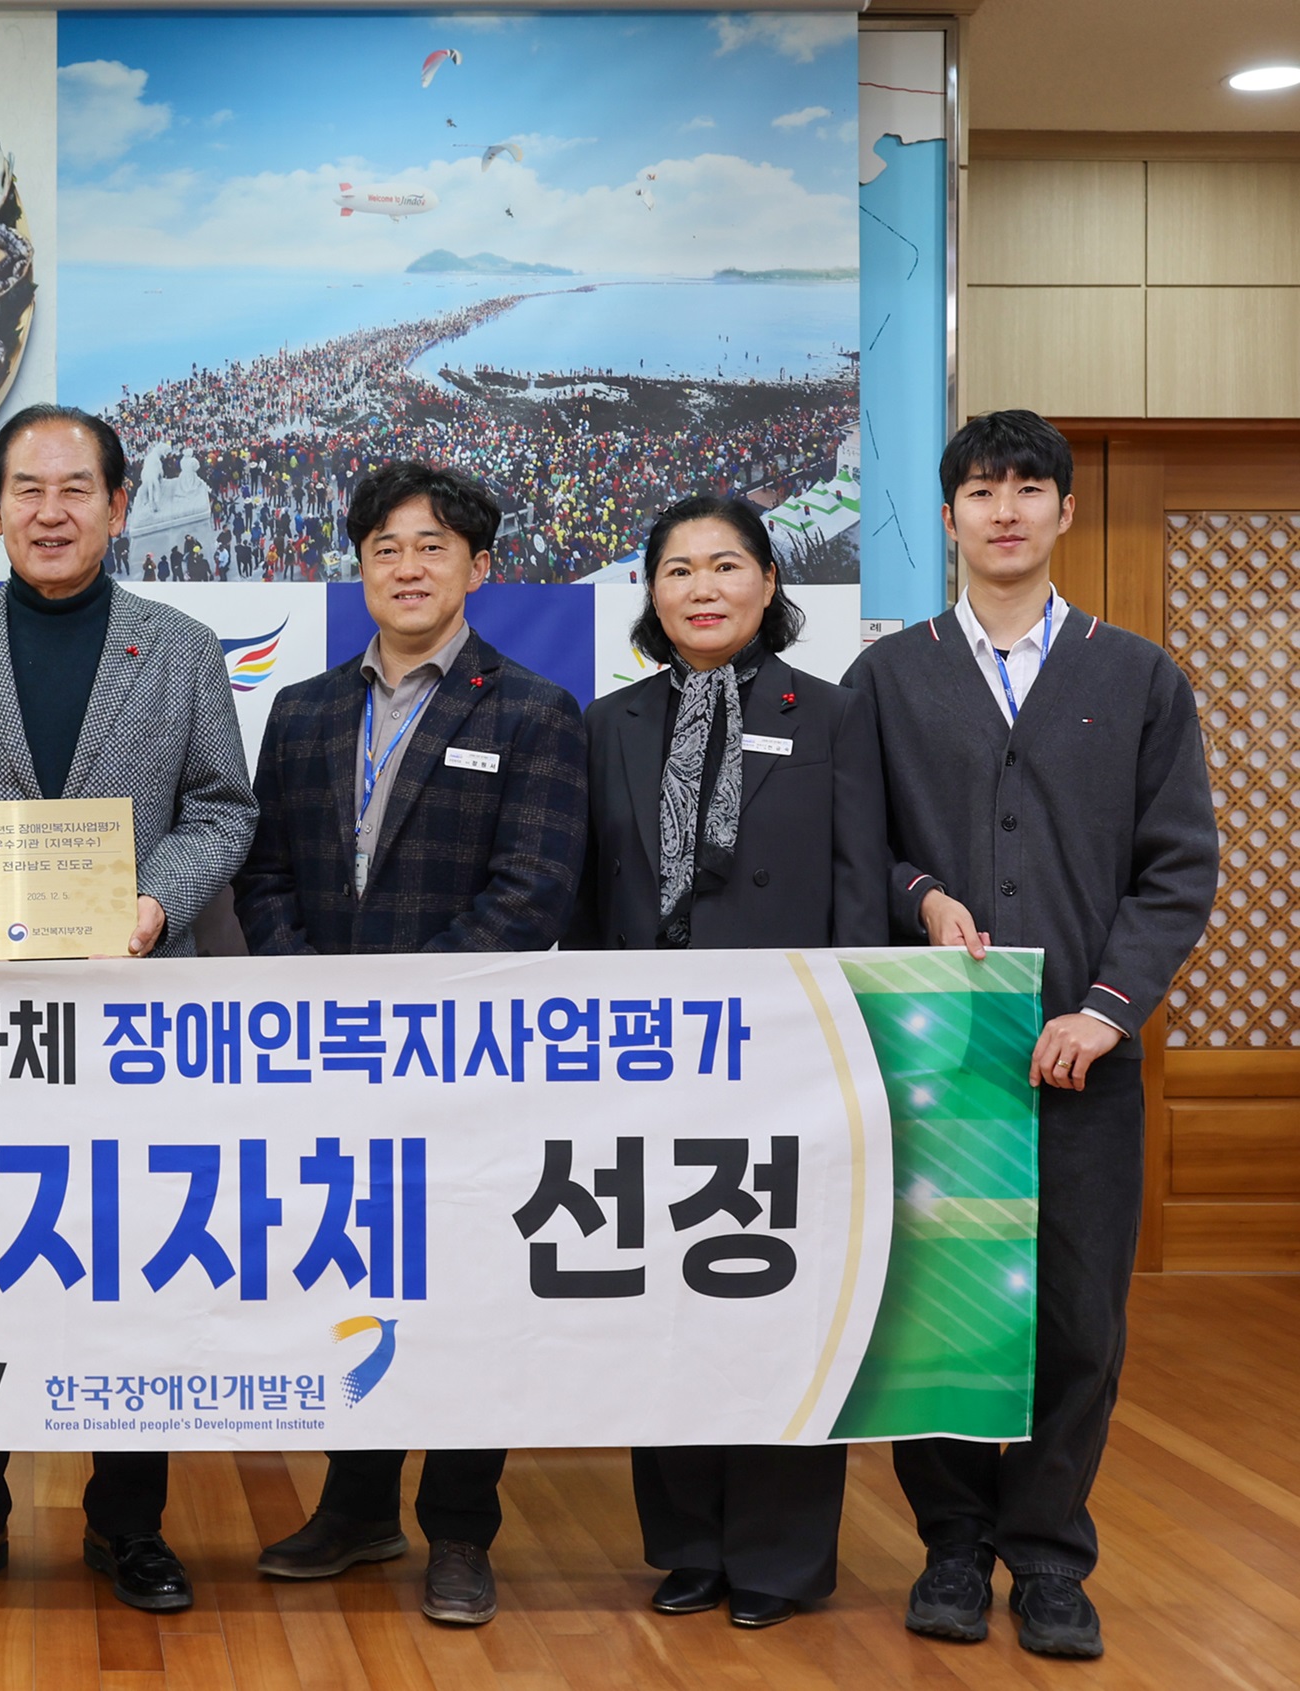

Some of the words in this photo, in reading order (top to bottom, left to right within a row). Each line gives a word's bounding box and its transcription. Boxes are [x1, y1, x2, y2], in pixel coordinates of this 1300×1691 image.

[367, 194, 393, 203] Welcome
[19, 822, 120, 834] 장애인복지사업평가
[2, 860, 51, 872] 전라남도
[57, 859, 93, 871] 진도군
[32, 926, 93, 936] 보건복지부장관
[103, 997, 751, 1085] 장애인복지사업평가
[511, 1135, 800, 1299] 선정
[45, 1375, 326, 1412] 한국장애인개발원
[45, 1419, 79, 1430] Korea
[83, 1419, 136, 1430] Disabled
[140, 1419, 191, 1432] people's
[194, 1418, 273, 1432] Development
[276, 1419, 325, 1430] Institute
